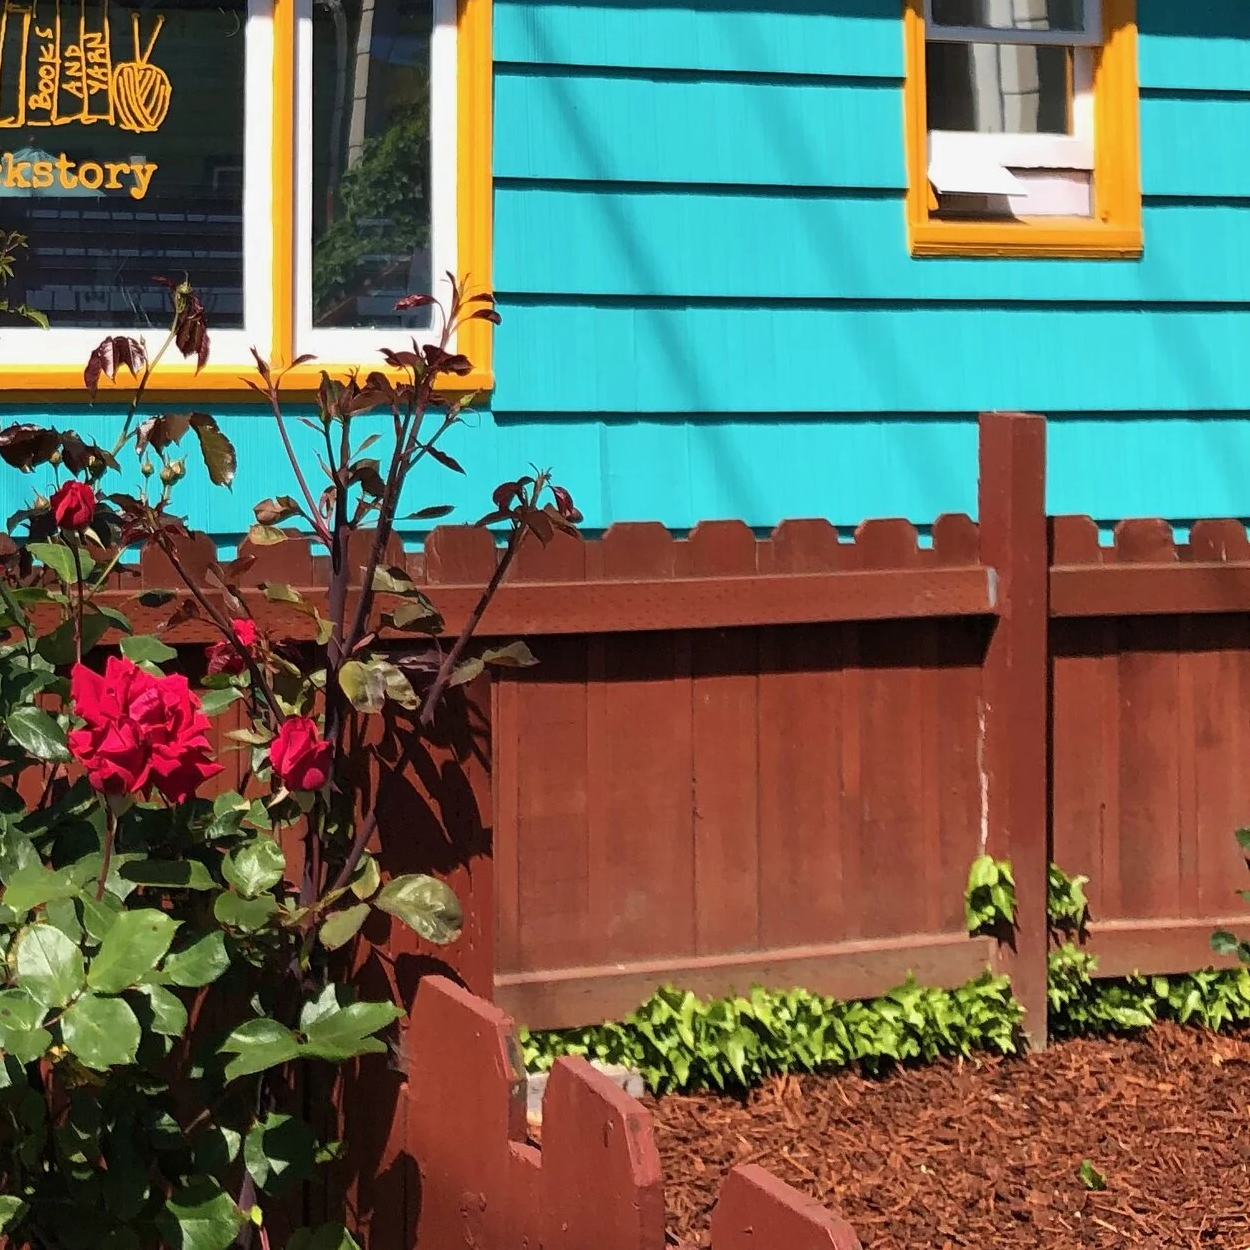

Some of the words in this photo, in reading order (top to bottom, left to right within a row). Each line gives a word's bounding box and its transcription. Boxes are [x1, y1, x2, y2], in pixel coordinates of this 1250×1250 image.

[29, 26, 54, 110] BOOKS
[62, 44, 83, 98] AND
[86, 32, 108, 95] YARN
